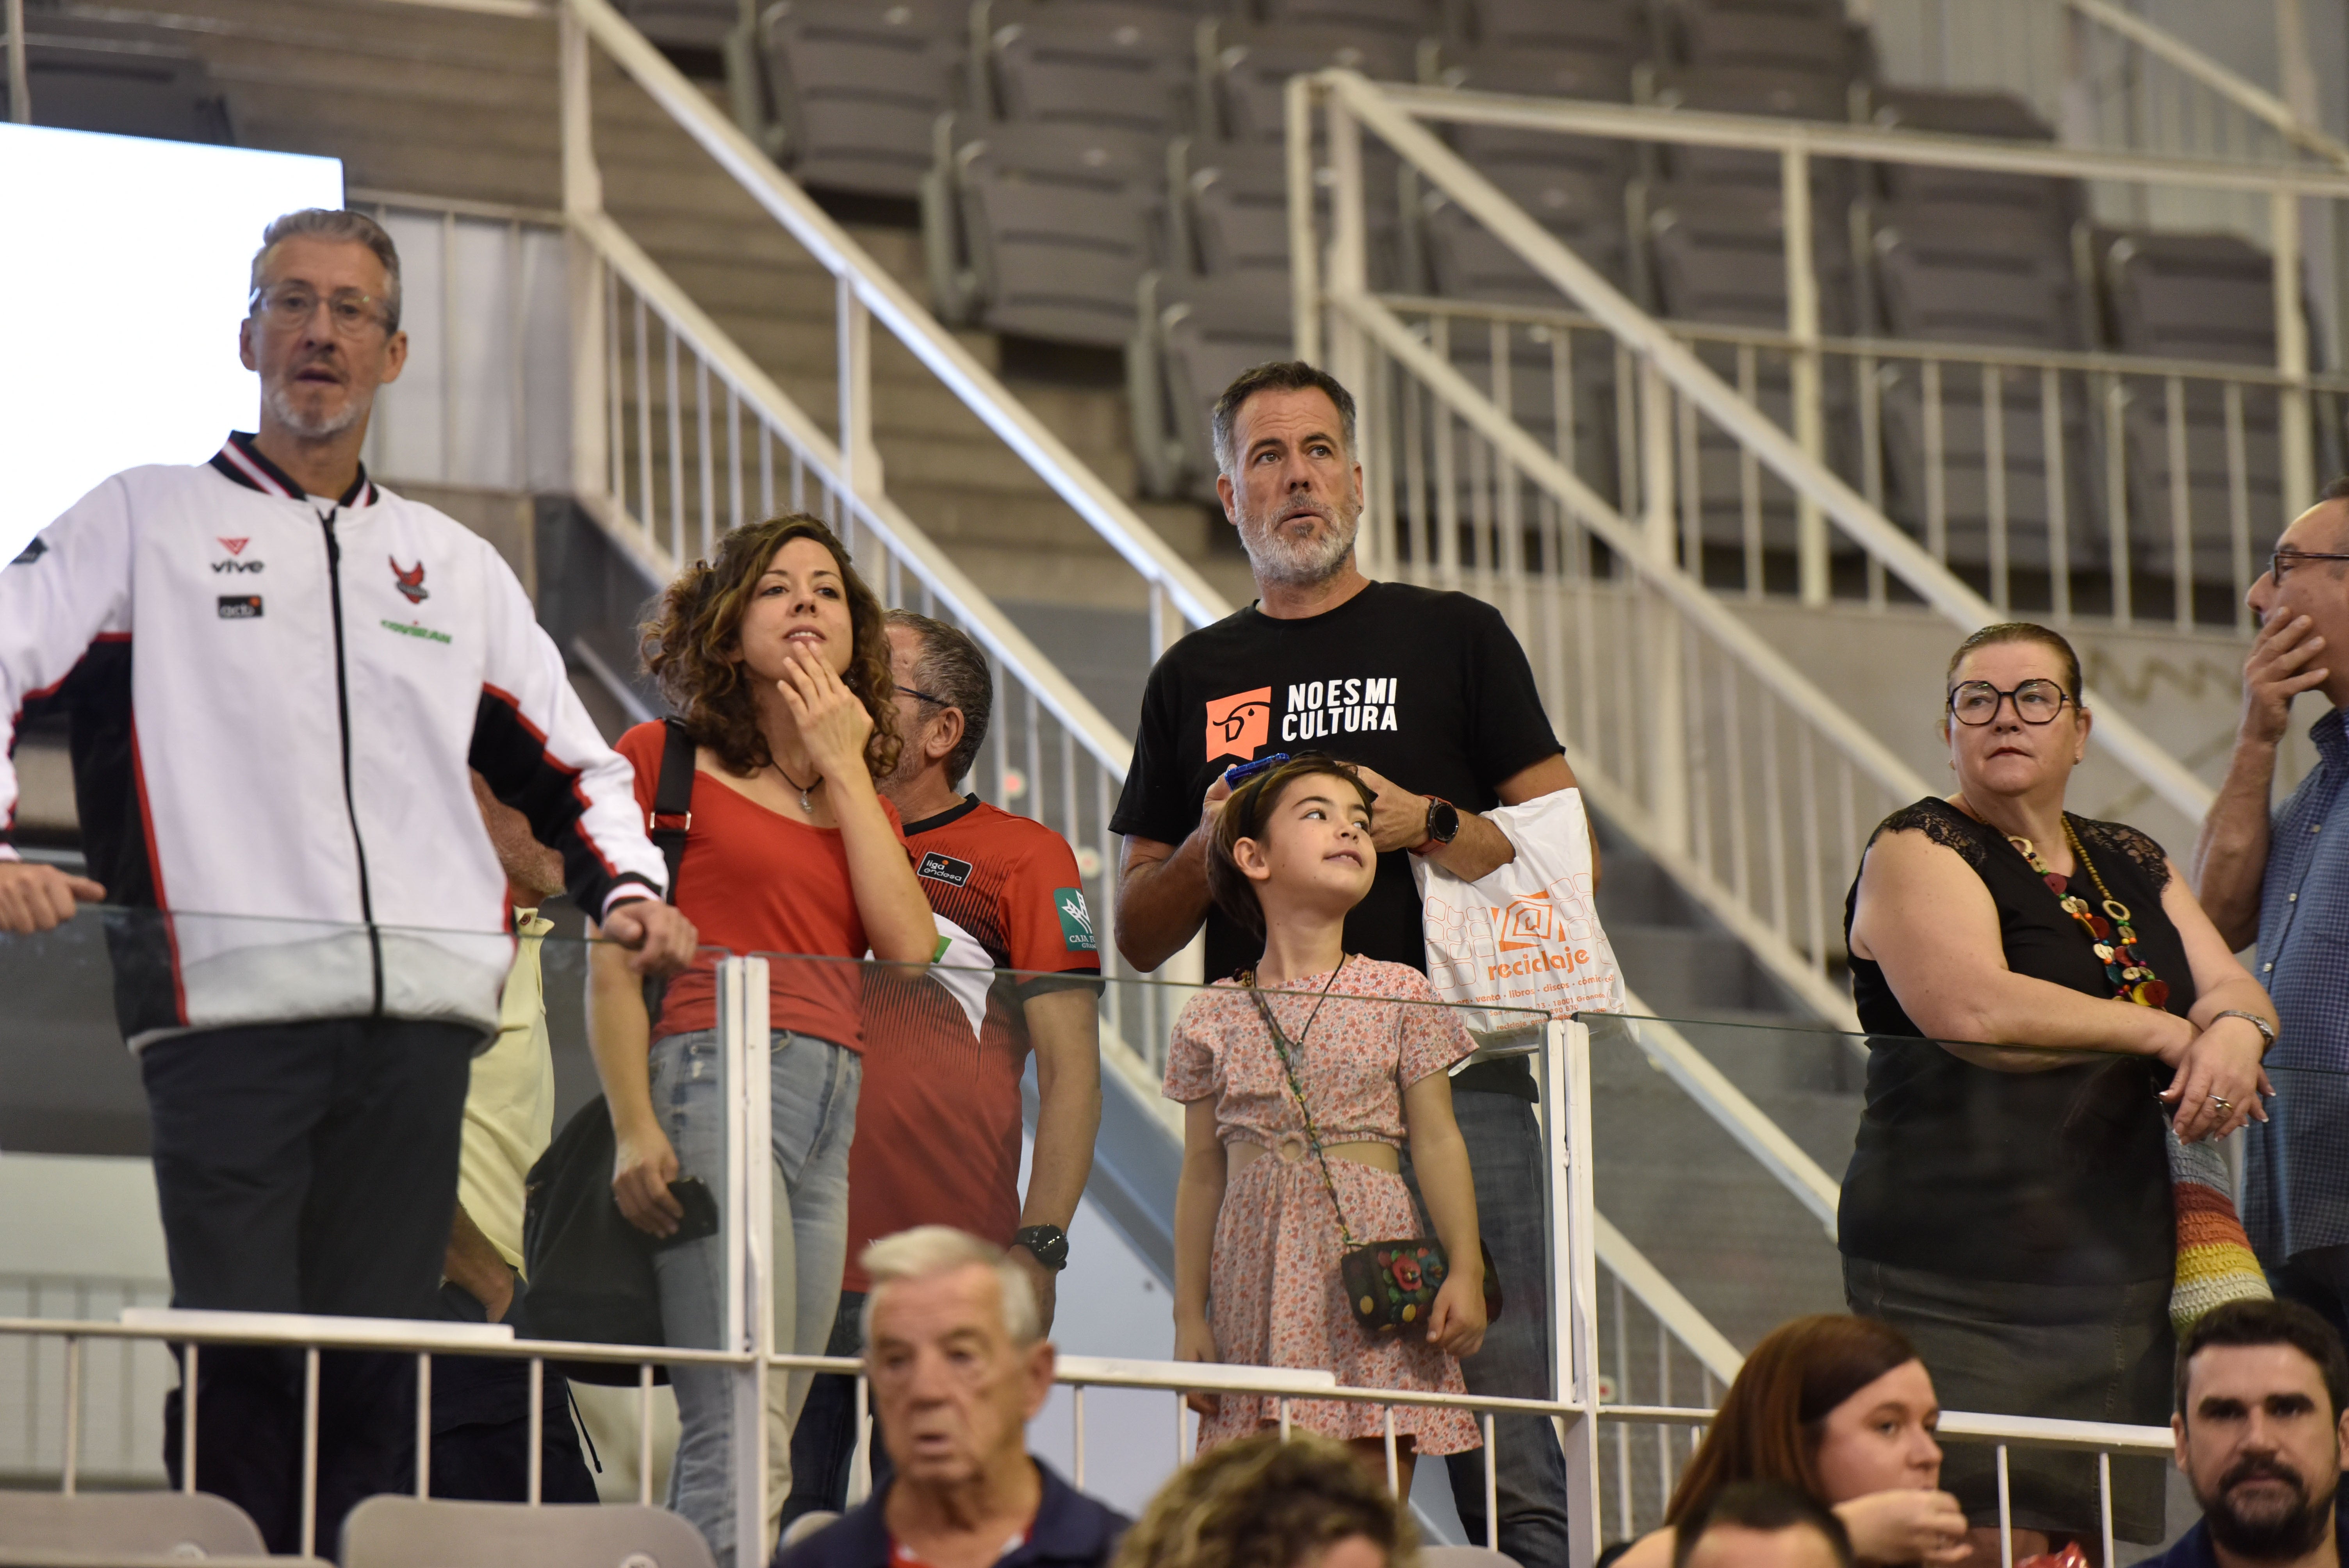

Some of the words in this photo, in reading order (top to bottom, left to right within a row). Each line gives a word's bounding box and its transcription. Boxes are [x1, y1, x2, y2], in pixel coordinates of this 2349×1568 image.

[212, 559, 265, 573] vive
[1287, 681, 1324, 712] NO
[1328, 679, 1361, 707] ES
[1365, 678, 1397, 704] MI
[1282, 706, 1398, 741] CULTURA
[926, 860, 945, 870] liga
[923, 868, 962, 882] endesa
[1069, 935, 1089, 943] CAJA
[1488, 946, 1590, 981] reciclaje
[1476, 994, 1501, 1003] venta
[1509, 989, 1535, 998] libros
[1543, 983, 1570, 992] discos
[1553, 998, 1574, 1006] 18001
[1577, 993, 1606, 1002] Granada
